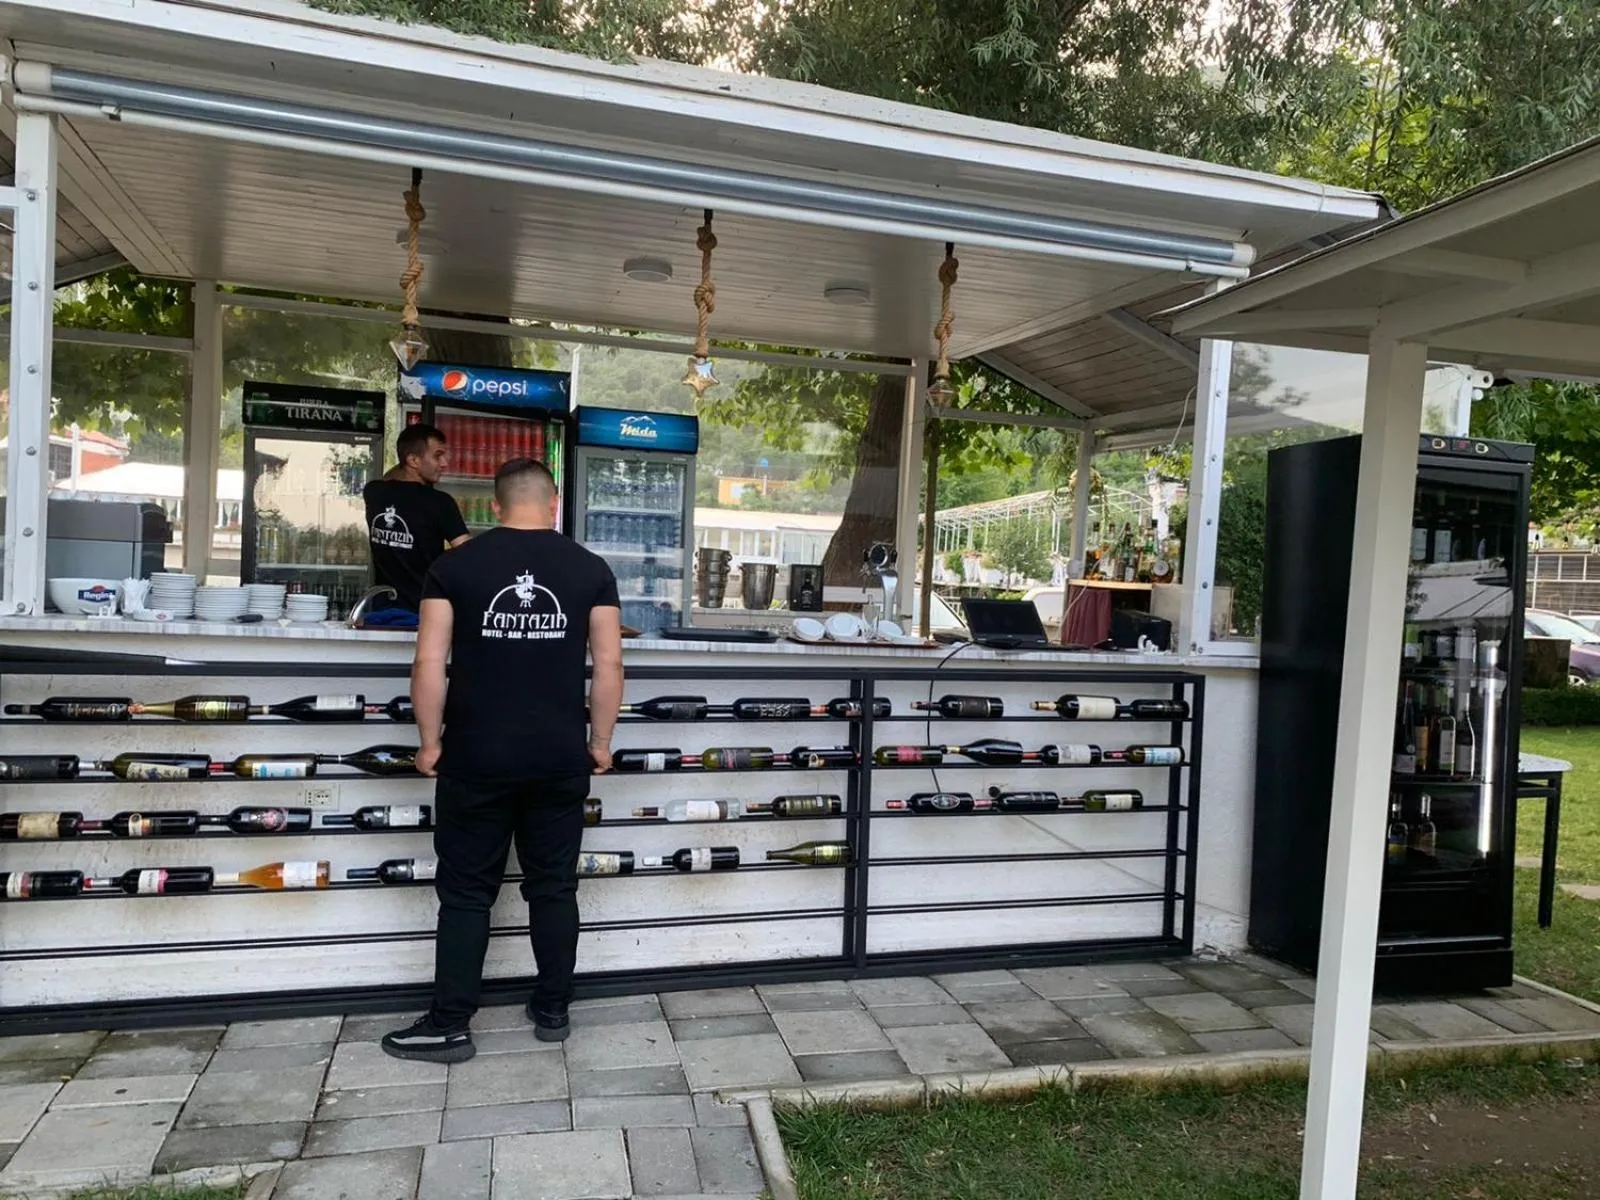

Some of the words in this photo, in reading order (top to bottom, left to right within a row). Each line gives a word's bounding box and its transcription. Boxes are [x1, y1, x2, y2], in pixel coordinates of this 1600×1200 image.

[472, 379, 527, 397] pepsi
[285, 406, 344, 421] TIRANA
[483, 611, 567, 629] FANTAZIA
[482, 629, 502, 637] HOTEL
